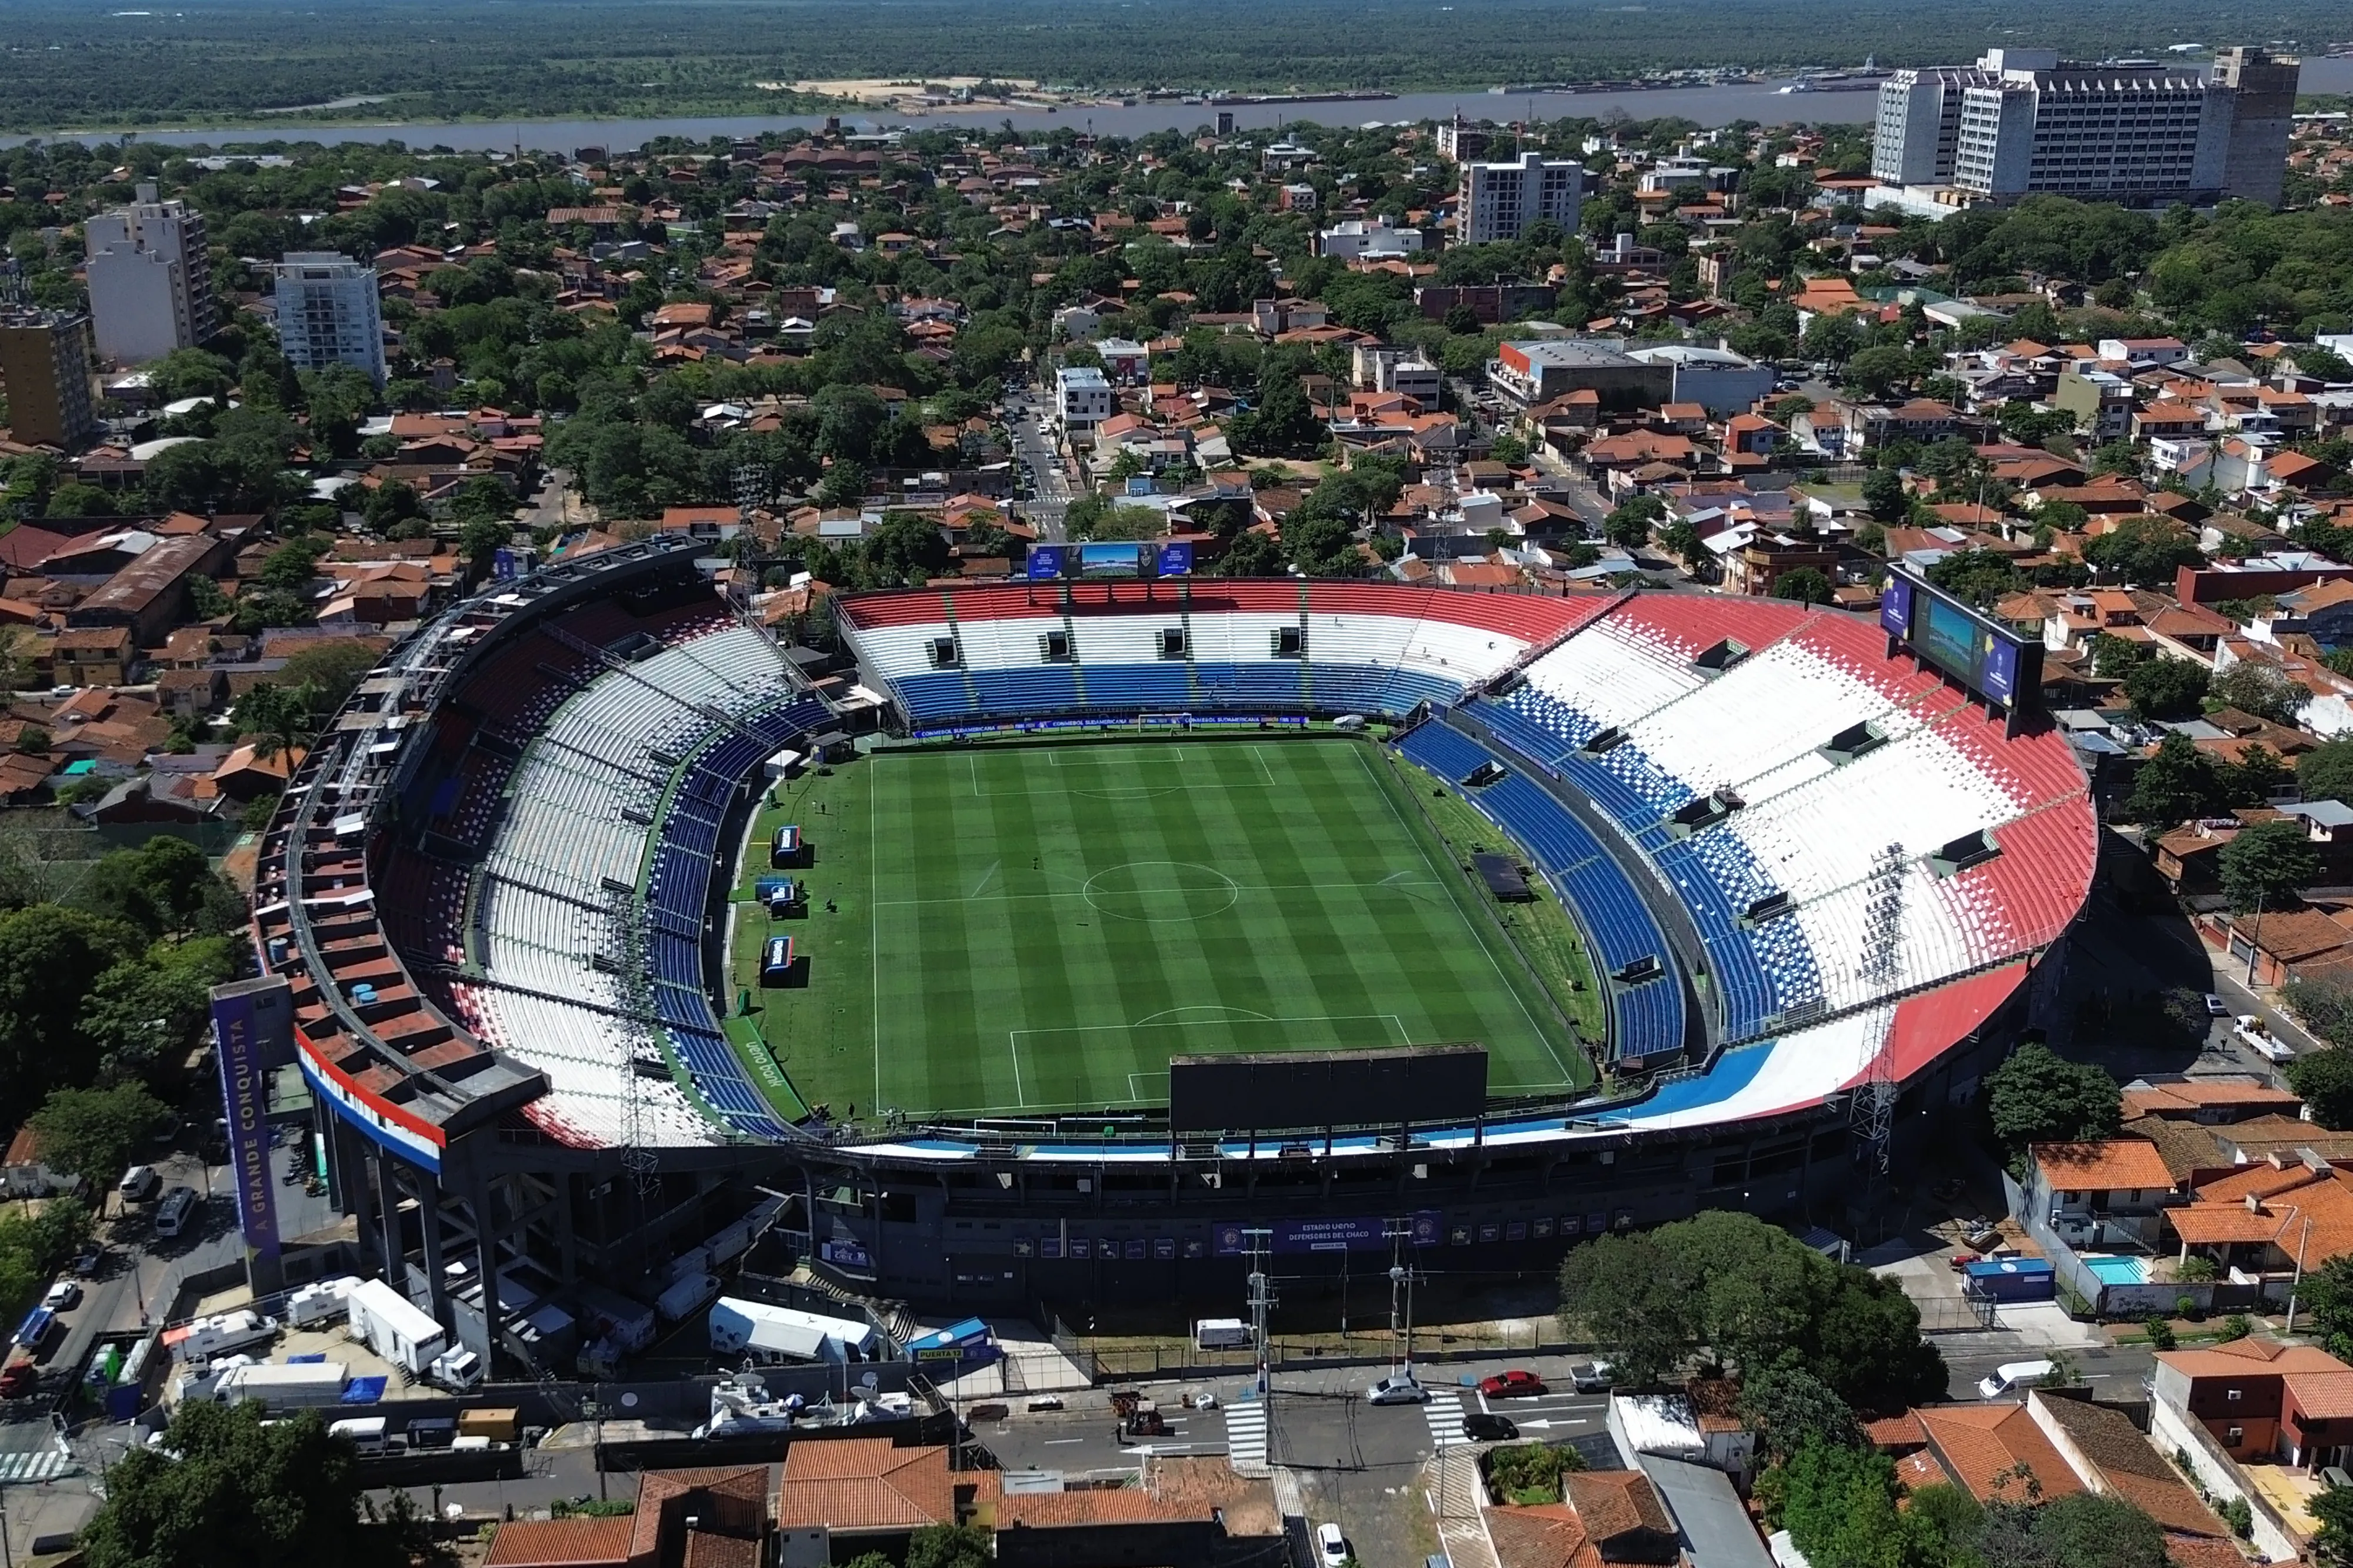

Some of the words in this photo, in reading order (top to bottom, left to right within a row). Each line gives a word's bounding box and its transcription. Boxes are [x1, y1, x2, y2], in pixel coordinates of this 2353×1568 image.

[230, 1019, 255, 1130] CONQUISTA
[745, 1041, 767, 1064] ueno
[759, 1063, 785, 1087] bank
[244, 1138, 265, 1213] GRANDE
[255, 1220, 268, 1230] A
